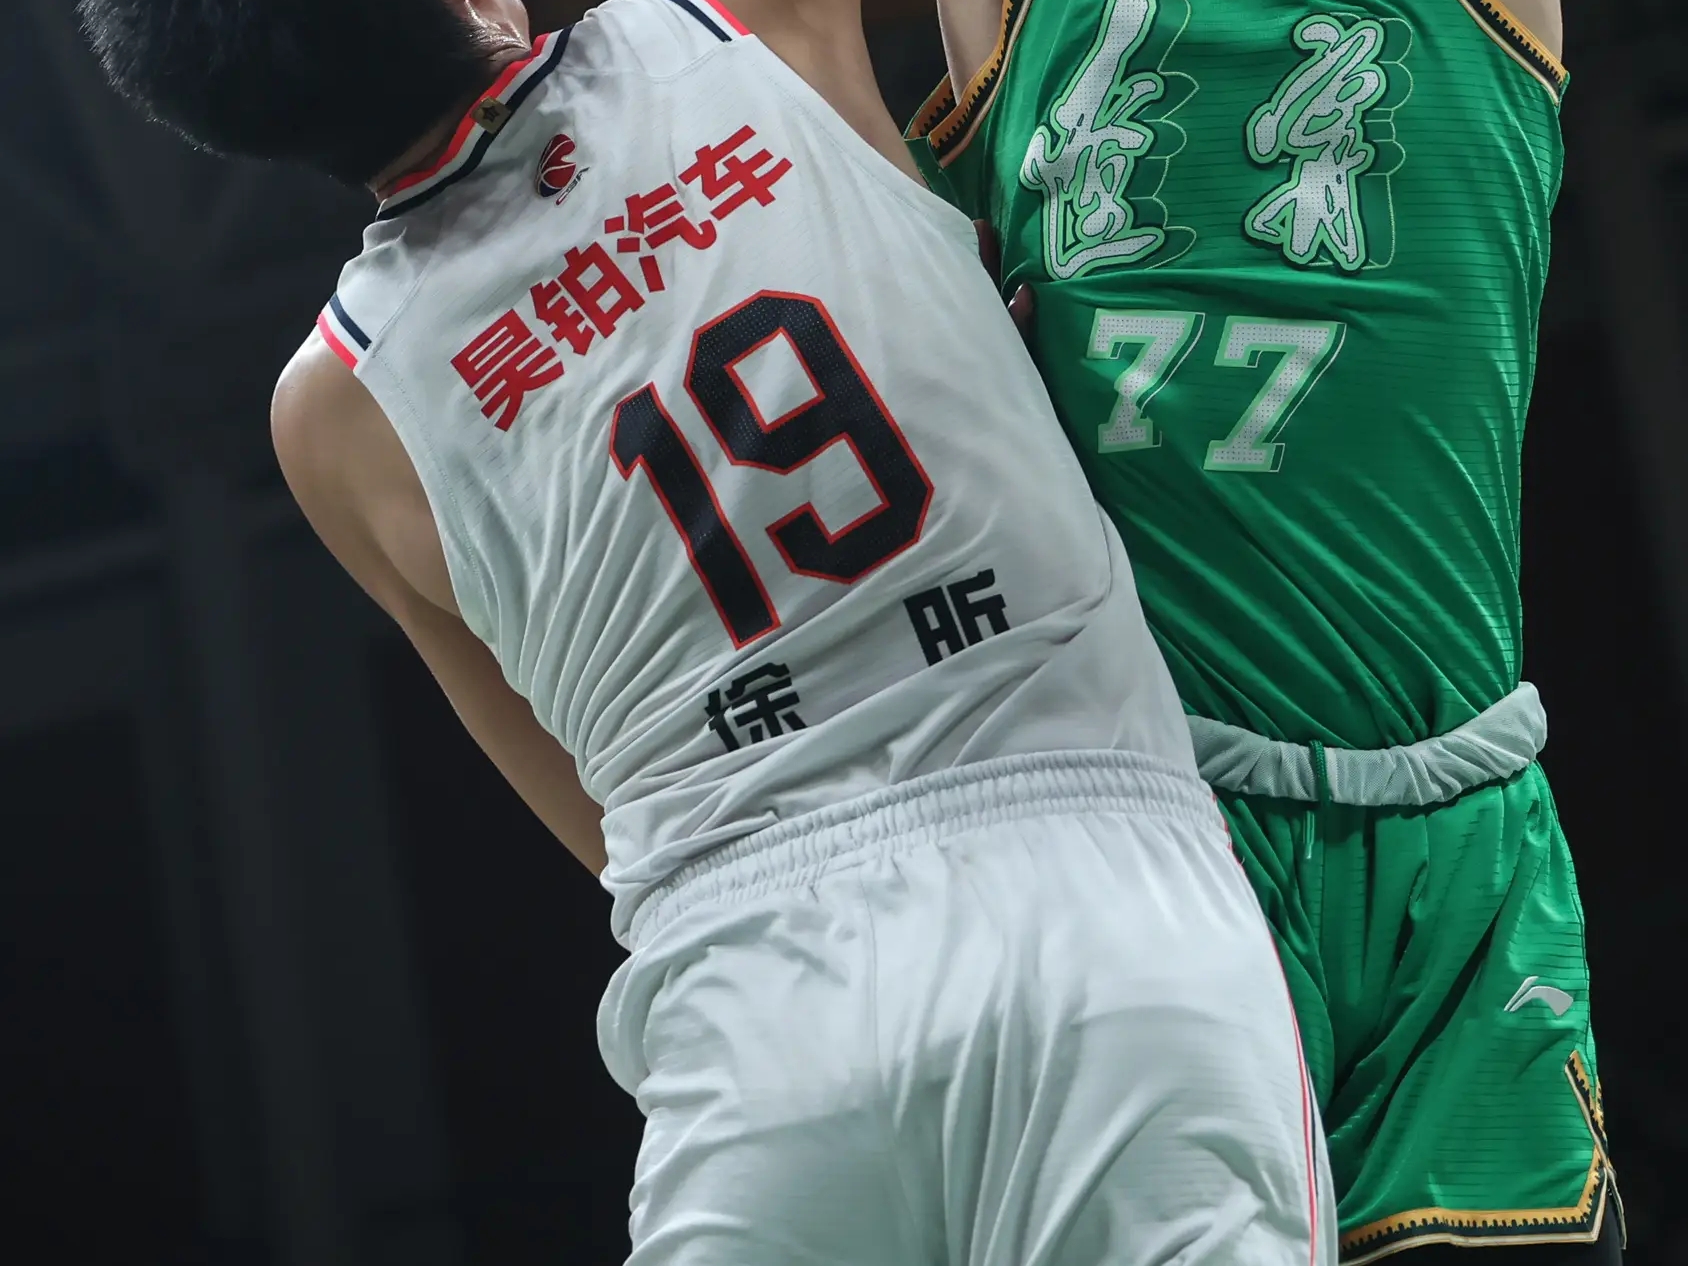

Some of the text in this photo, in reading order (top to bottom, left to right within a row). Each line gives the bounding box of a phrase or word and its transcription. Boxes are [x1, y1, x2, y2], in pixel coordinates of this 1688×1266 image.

[450, 124, 793, 432] 昊铂汽车
[1086, 307, 1346, 472] 77
[608, 288, 935, 651] 19
